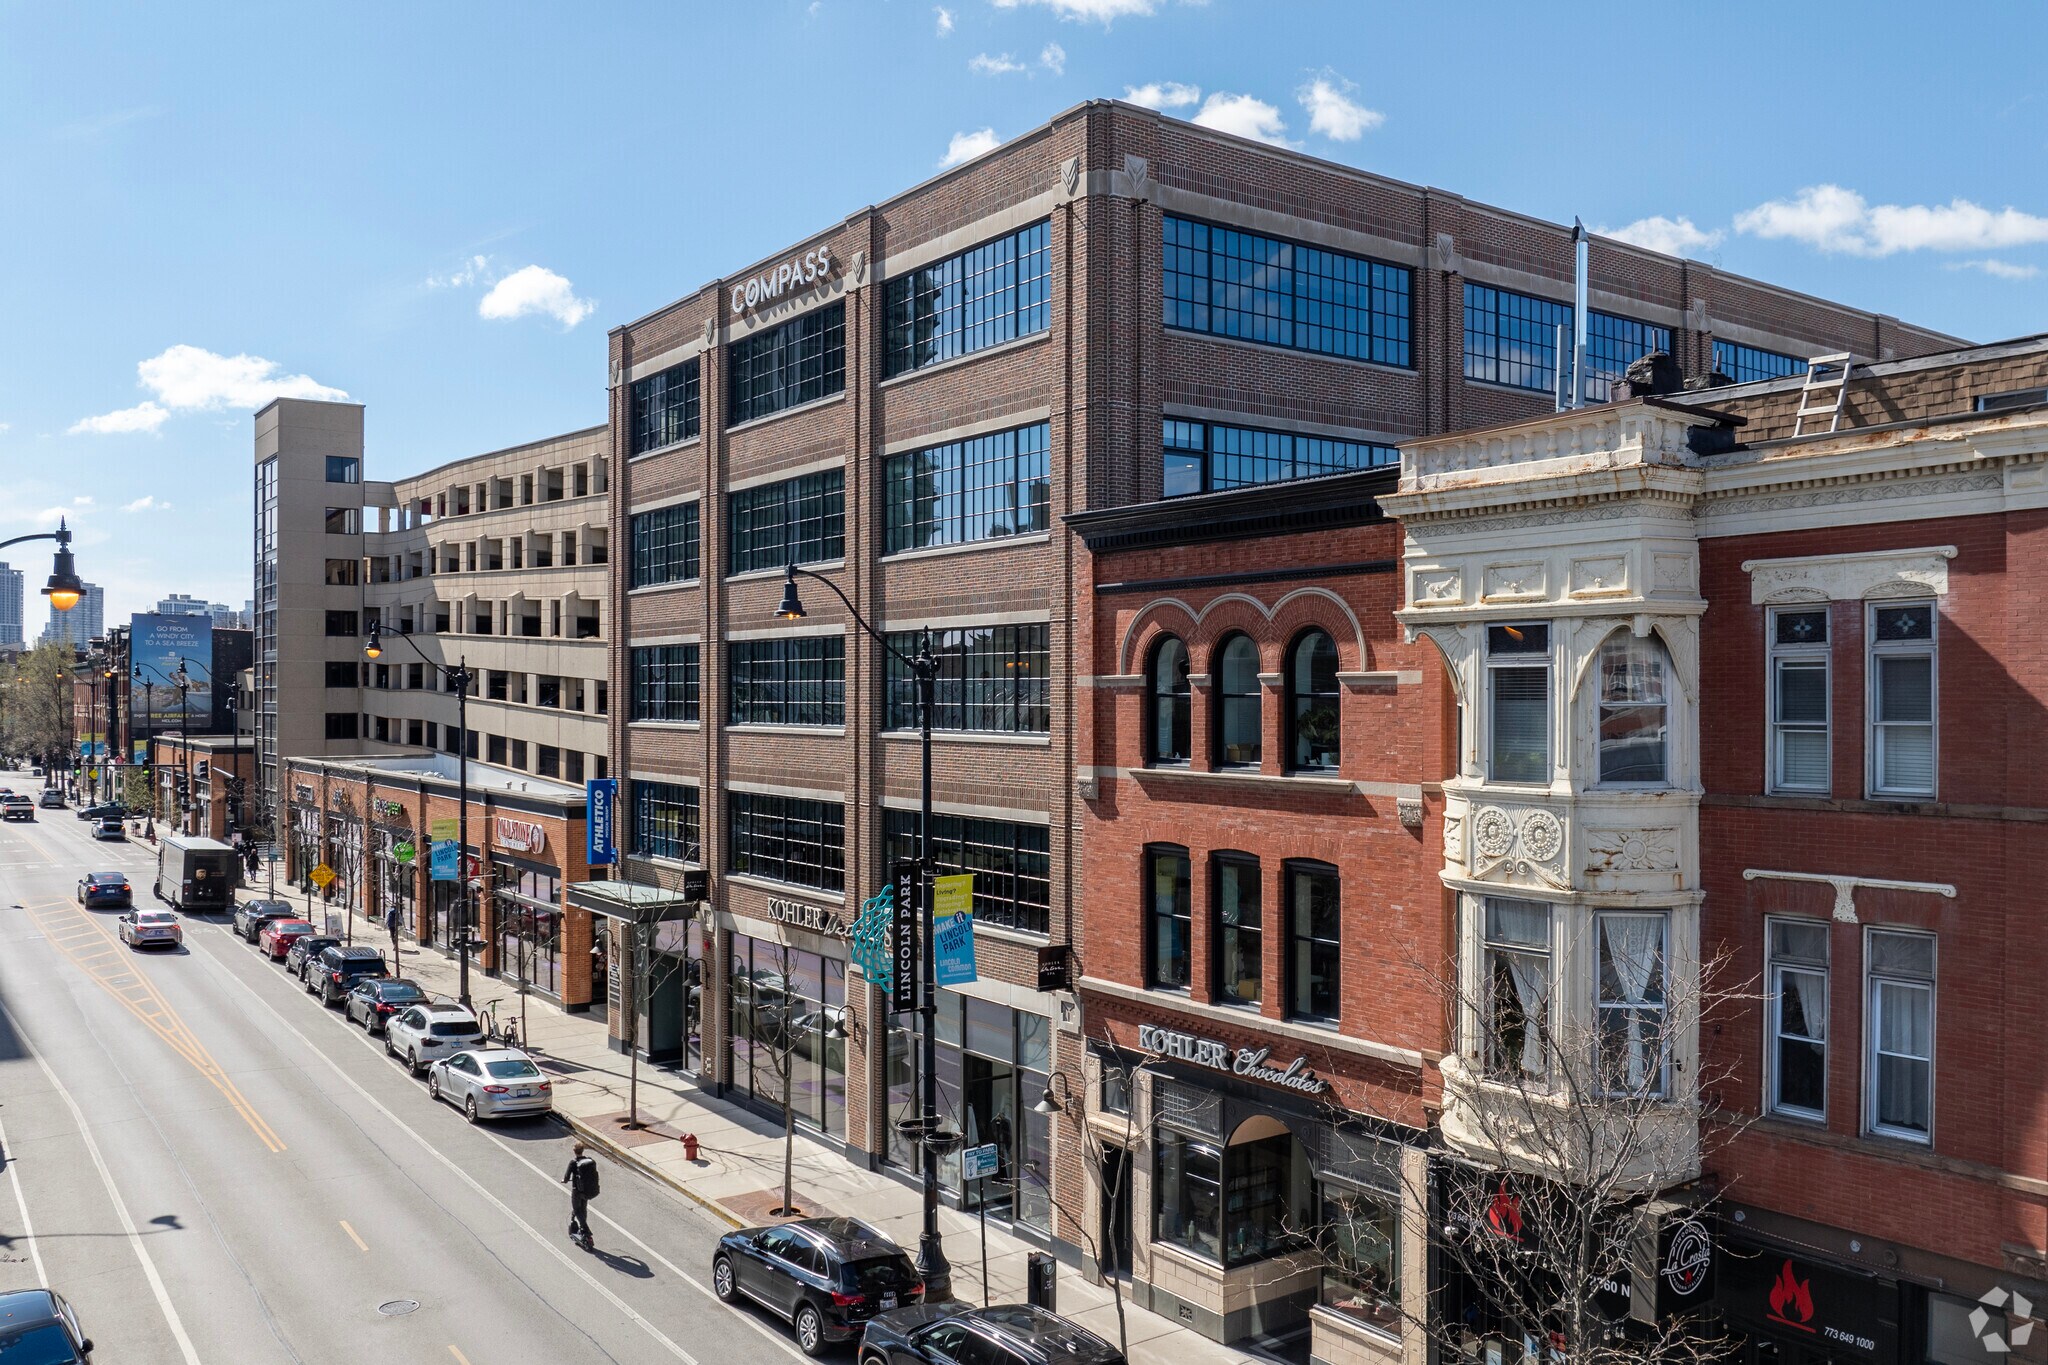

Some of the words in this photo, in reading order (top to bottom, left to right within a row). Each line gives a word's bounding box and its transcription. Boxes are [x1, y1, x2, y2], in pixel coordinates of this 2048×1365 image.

[732, 245, 830, 313] COMPASS
[592, 789, 604, 854] ATHLETICO
[437, 854, 453, 863] PARK
[900, 874, 911, 918] PARK
[936, 888, 956, 896] Living?
[767, 897, 824, 931] KOHLER
[934, 918, 955, 934] MAKE
[956, 912, 964, 924] it
[939, 921, 973, 944] LINCOLN
[943, 936, 966, 954] PARK
[900, 924, 911, 1001] LINCOLN
[1138, 1024, 1230, 1071] KOHLER
[1233, 1047, 1325, 1094] Chocolates
[1660, 1246, 1679, 1276] La
[1680, 1239, 1711, 1267] Crosta
[1621, 1283, 1630, 1298] N
[1824, 1326, 1839, 1339] 773
[1840, 1331, 1854, 1344] 649
[1856, 1337, 1875, 1350] 1000
